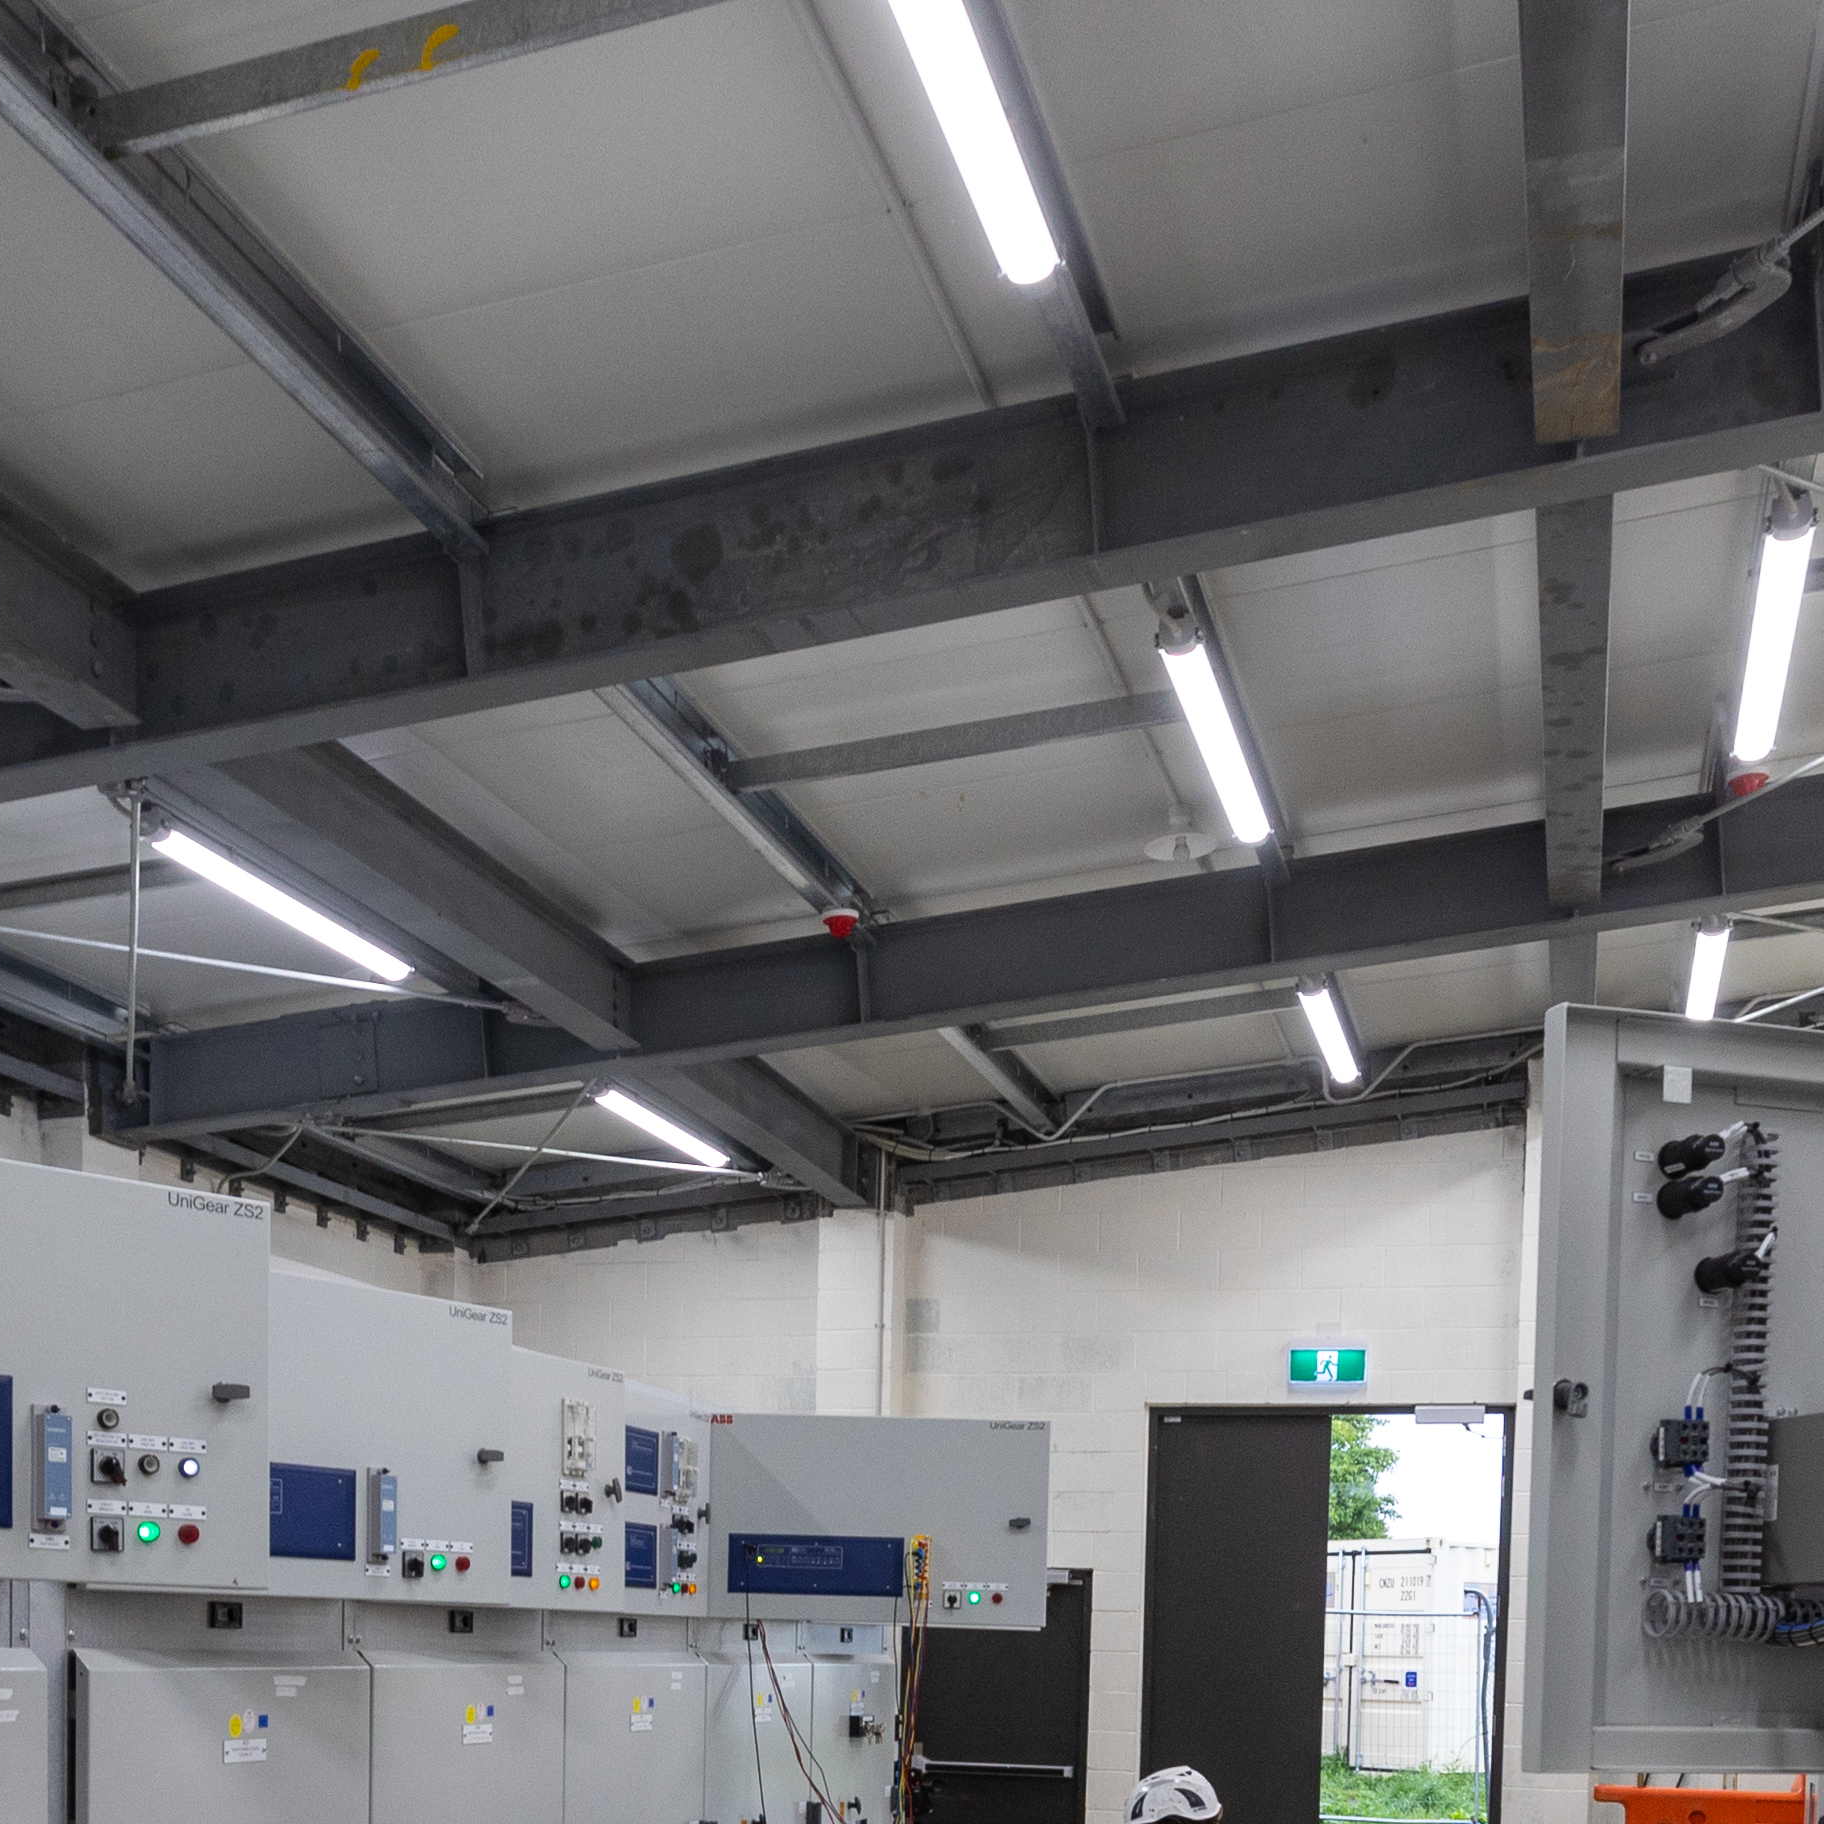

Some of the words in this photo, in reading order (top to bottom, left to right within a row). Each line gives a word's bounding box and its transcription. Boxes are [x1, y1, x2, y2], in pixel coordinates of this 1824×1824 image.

[167, 1191, 229, 1216] UniGear
[233, 1202, 265, 1221] ZS2
[449, 1306, 486, 1323] UniGear
[489, 1312, 508, 1326] ZS2
[711, 1414, 733, 1425] ABB
[989, 1421, 1025, 1431] UniGear
[1027, 1422, 1046, 1431] ZS2
[1400, 1575, 1424, 1588] 211019
